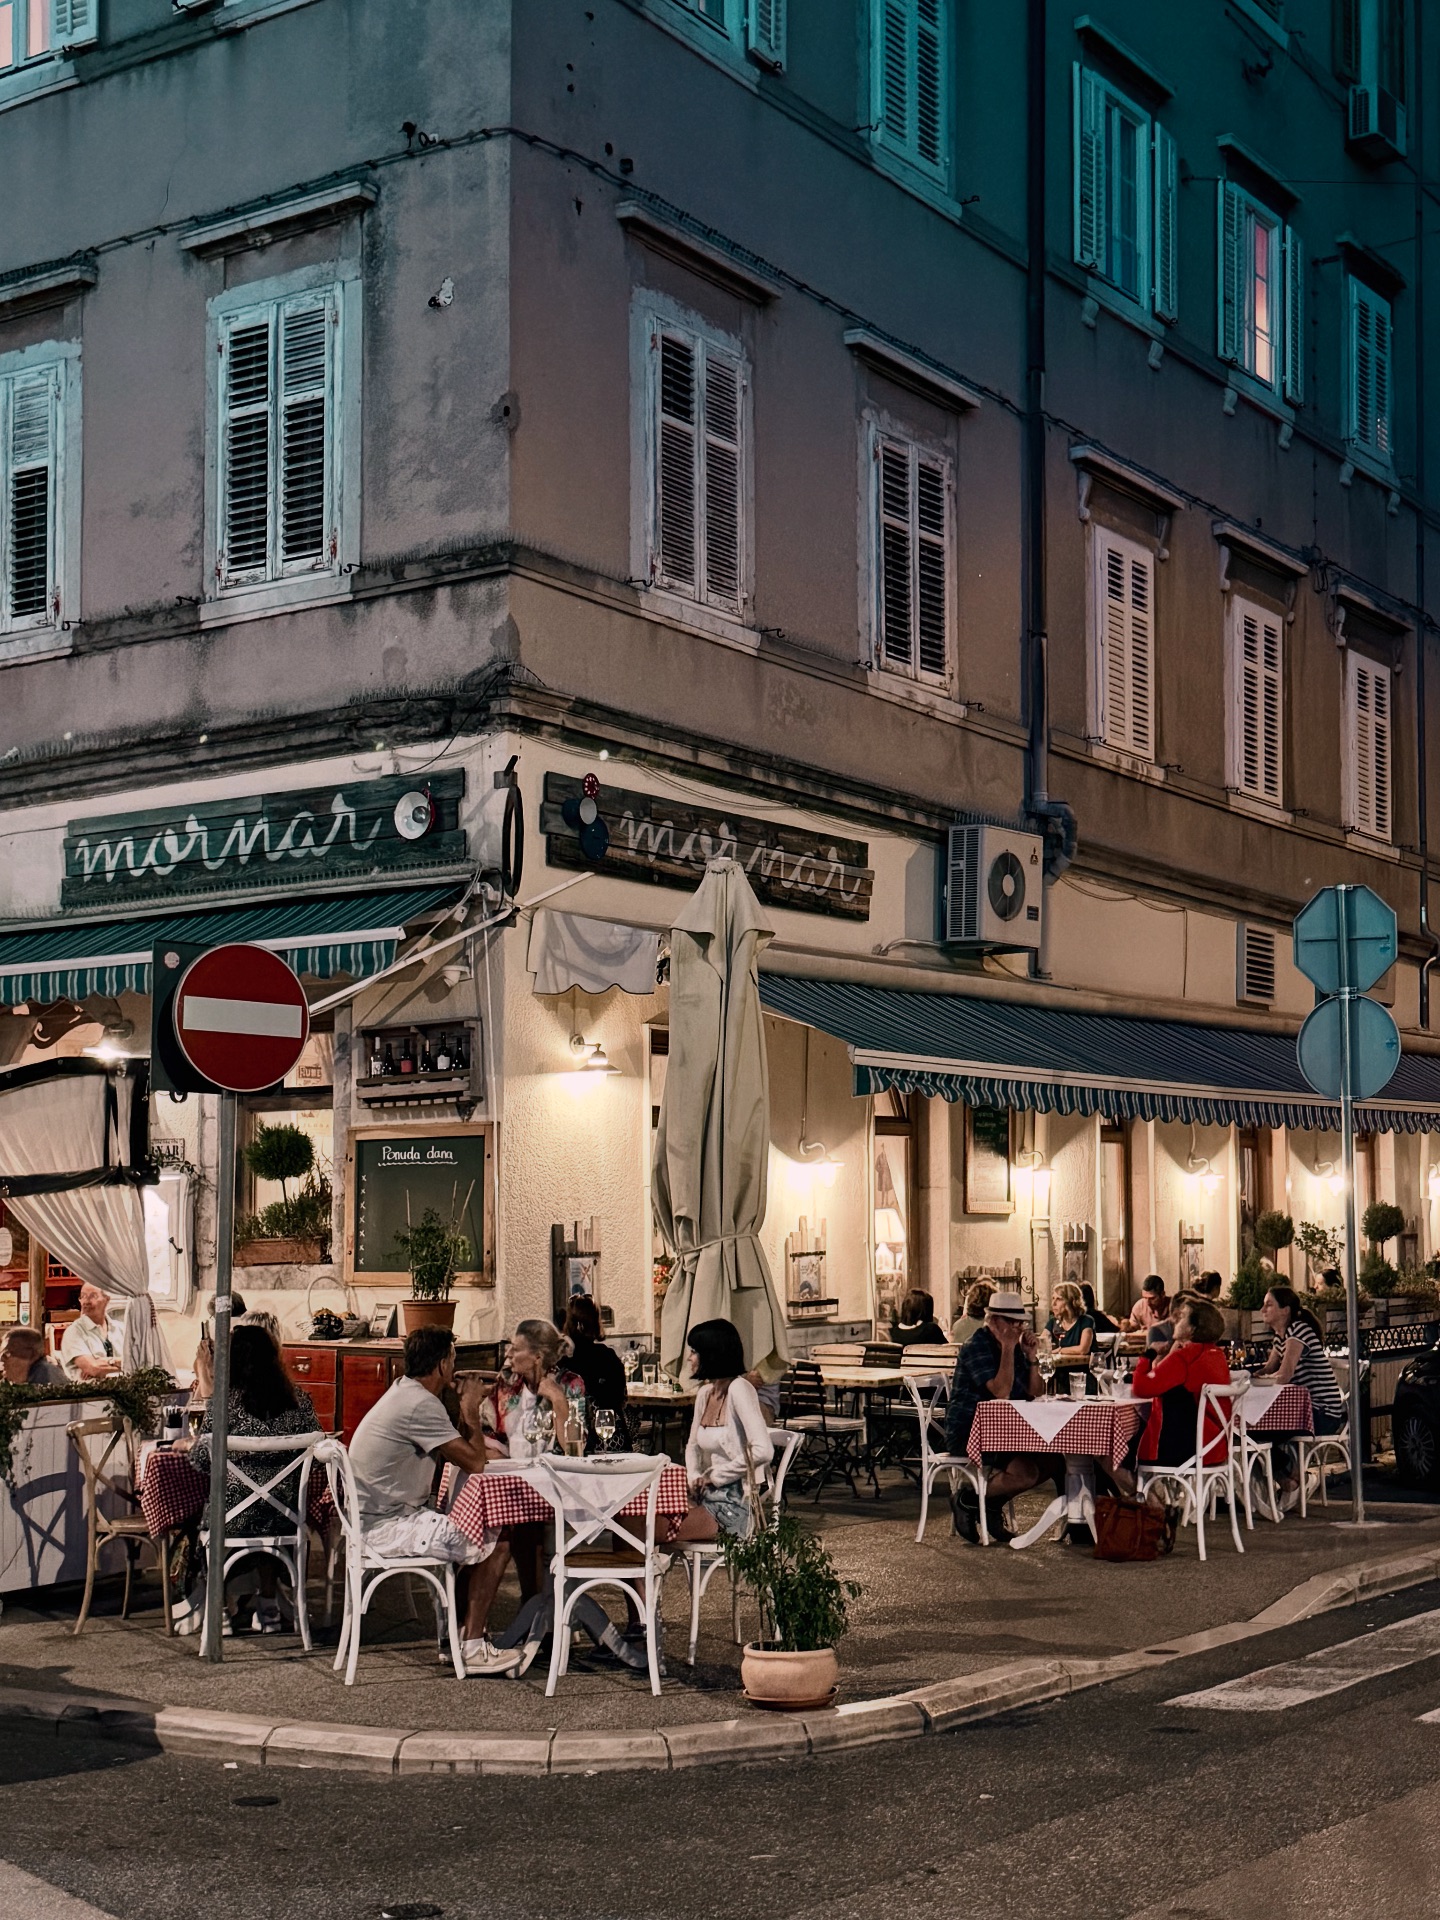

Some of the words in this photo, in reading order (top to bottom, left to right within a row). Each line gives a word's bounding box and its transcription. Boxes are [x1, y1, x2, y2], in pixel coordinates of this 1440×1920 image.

[75, 793, 382, 883] mornar
[382, 1146, 420, 1160] Ponuda
[426, 1146, 453, 1160] dana
